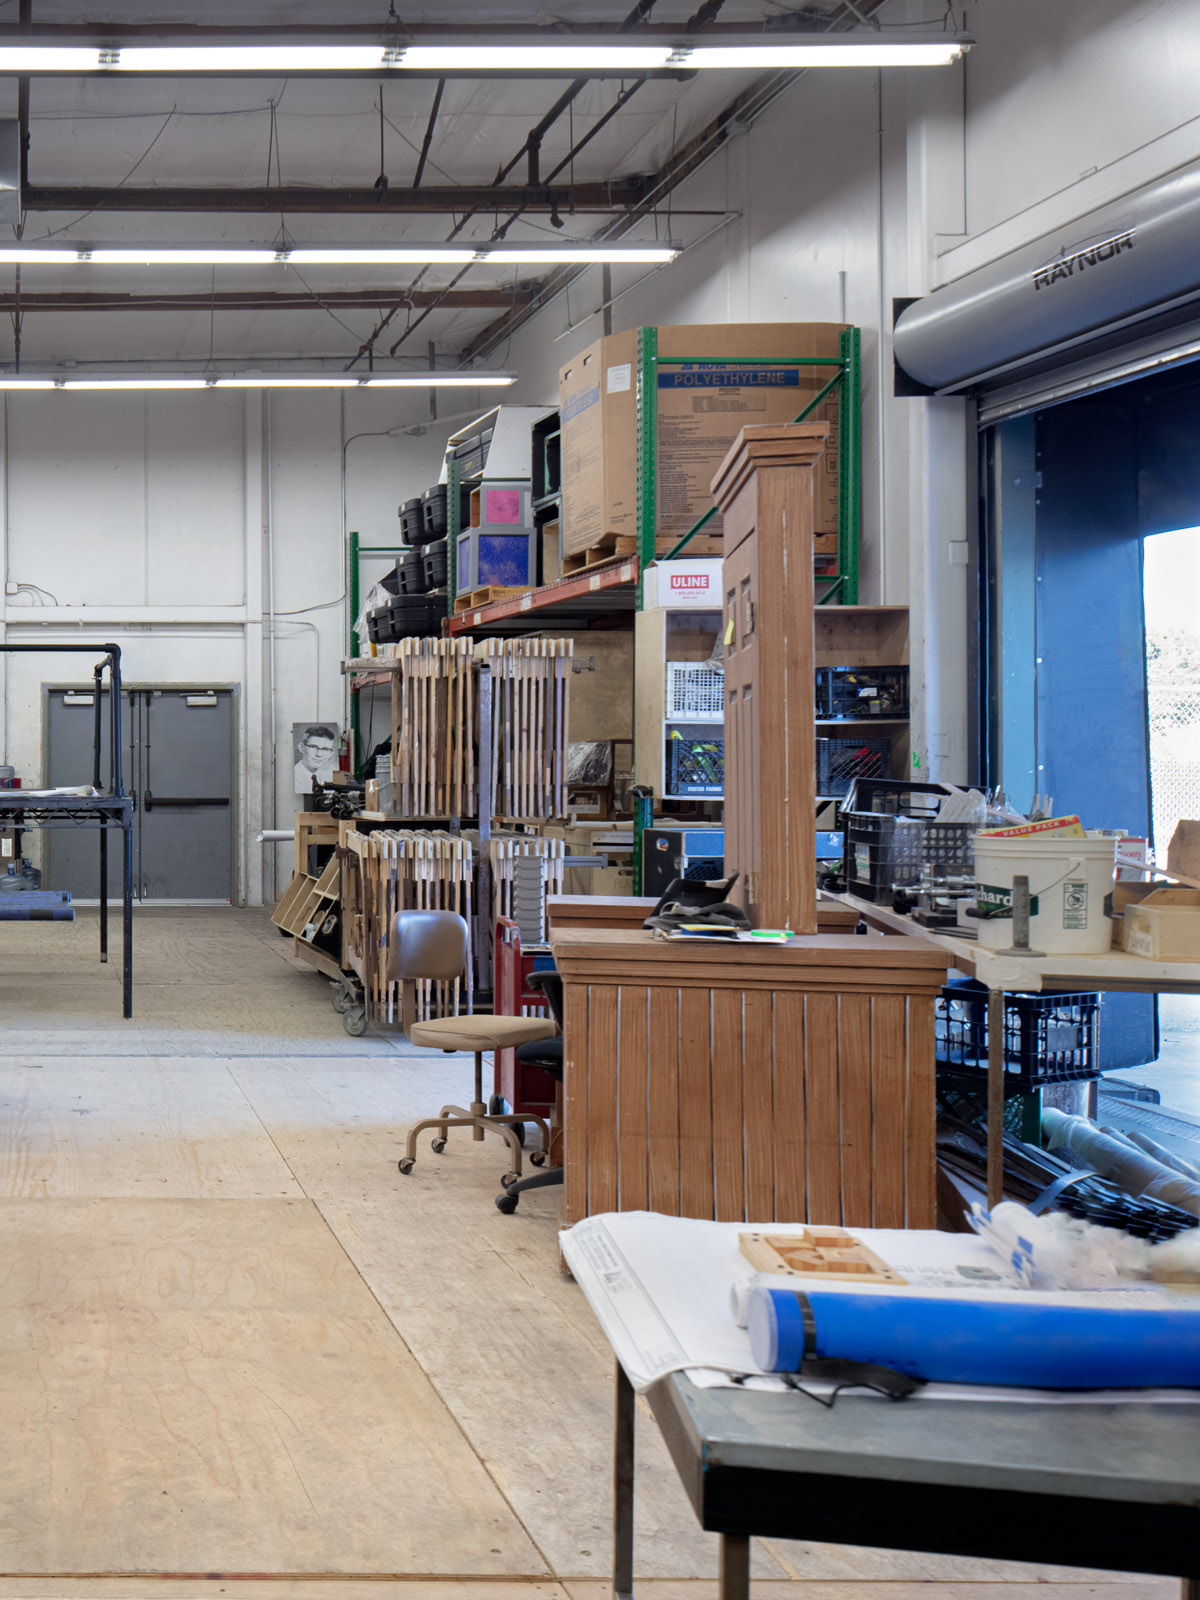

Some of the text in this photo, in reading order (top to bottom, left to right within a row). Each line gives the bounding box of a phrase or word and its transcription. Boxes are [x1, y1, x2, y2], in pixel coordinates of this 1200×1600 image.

[1033, 233, 1134, 291] RAYNOR
[673, 371, 785, 386] POLYETHYLENE
[672, 576, 708, 588] ULINE
[1003, 820, 1061, 837] VALUE PACK
